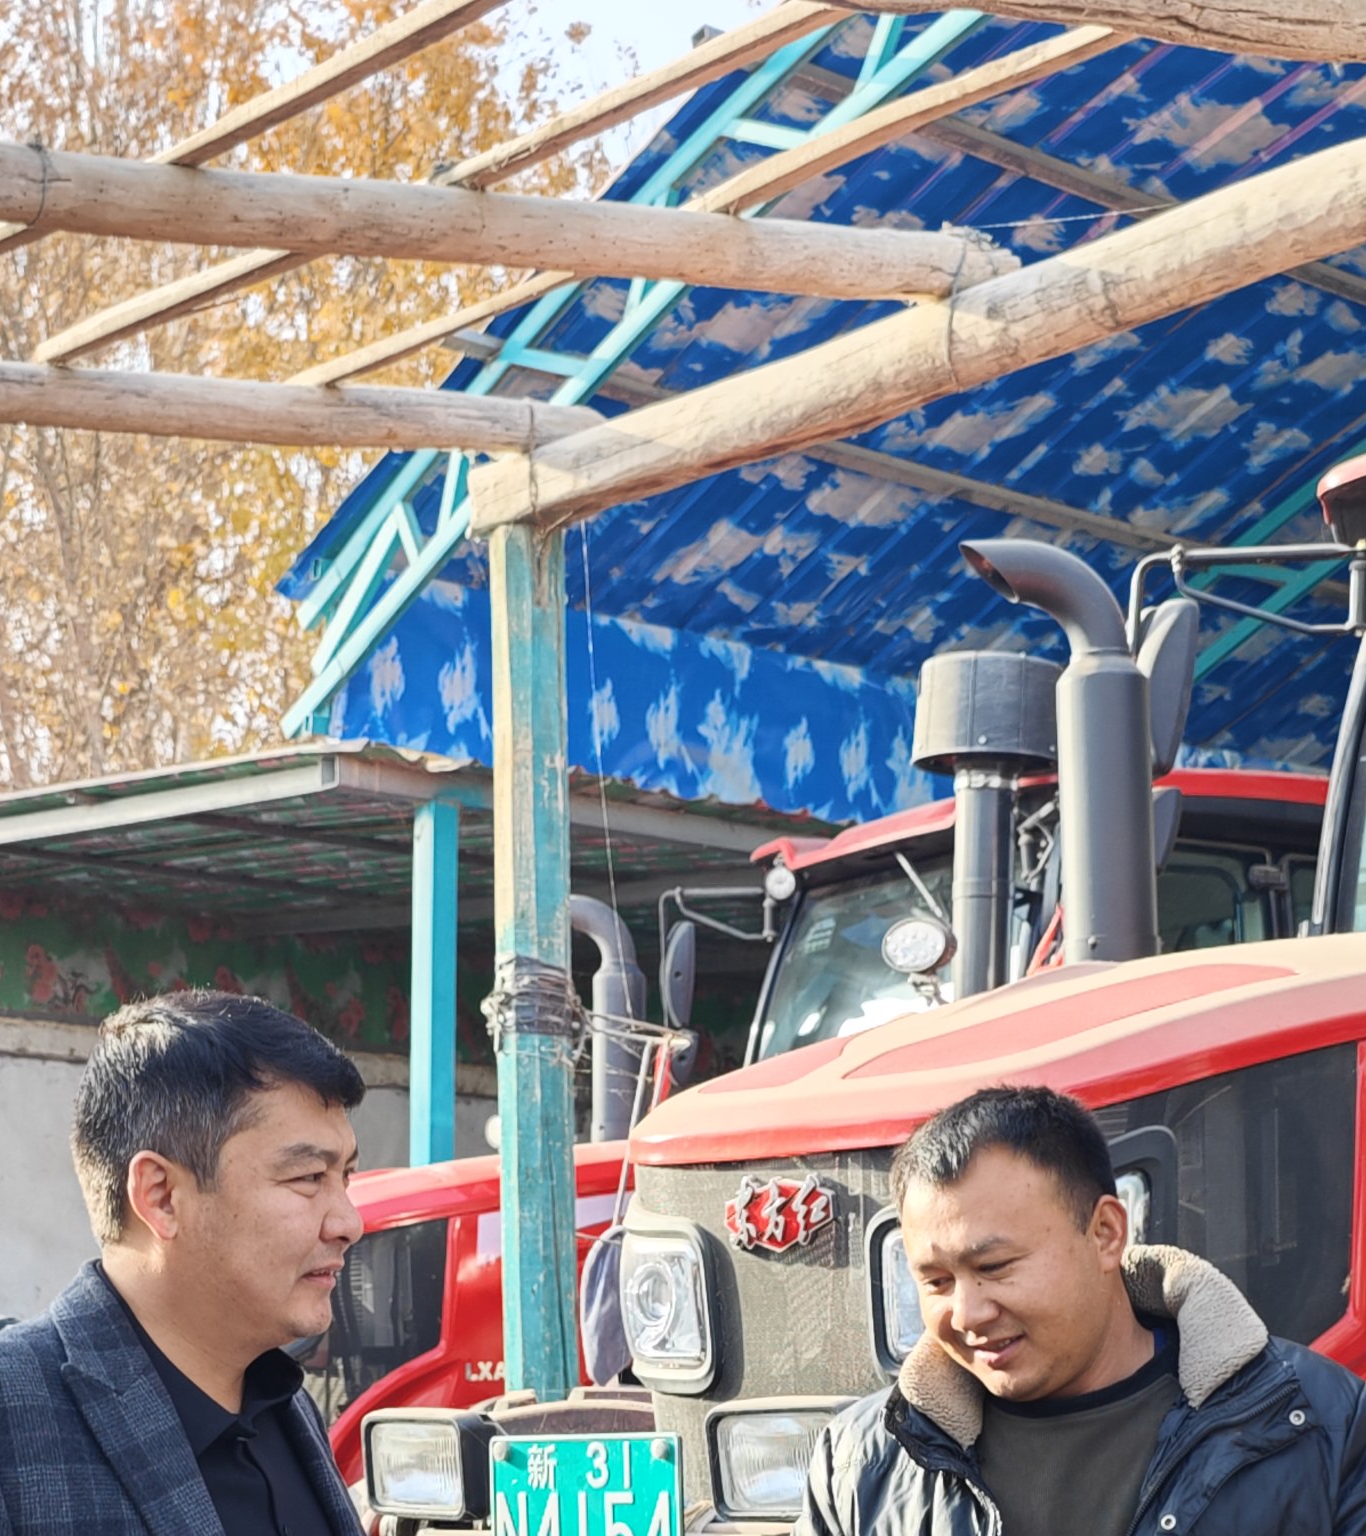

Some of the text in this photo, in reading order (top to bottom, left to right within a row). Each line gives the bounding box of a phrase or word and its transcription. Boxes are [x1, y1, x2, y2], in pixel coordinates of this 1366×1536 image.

[730, 1172, 835, 1250] 东方红
[527, 1441, 631, 1490] 新 31
